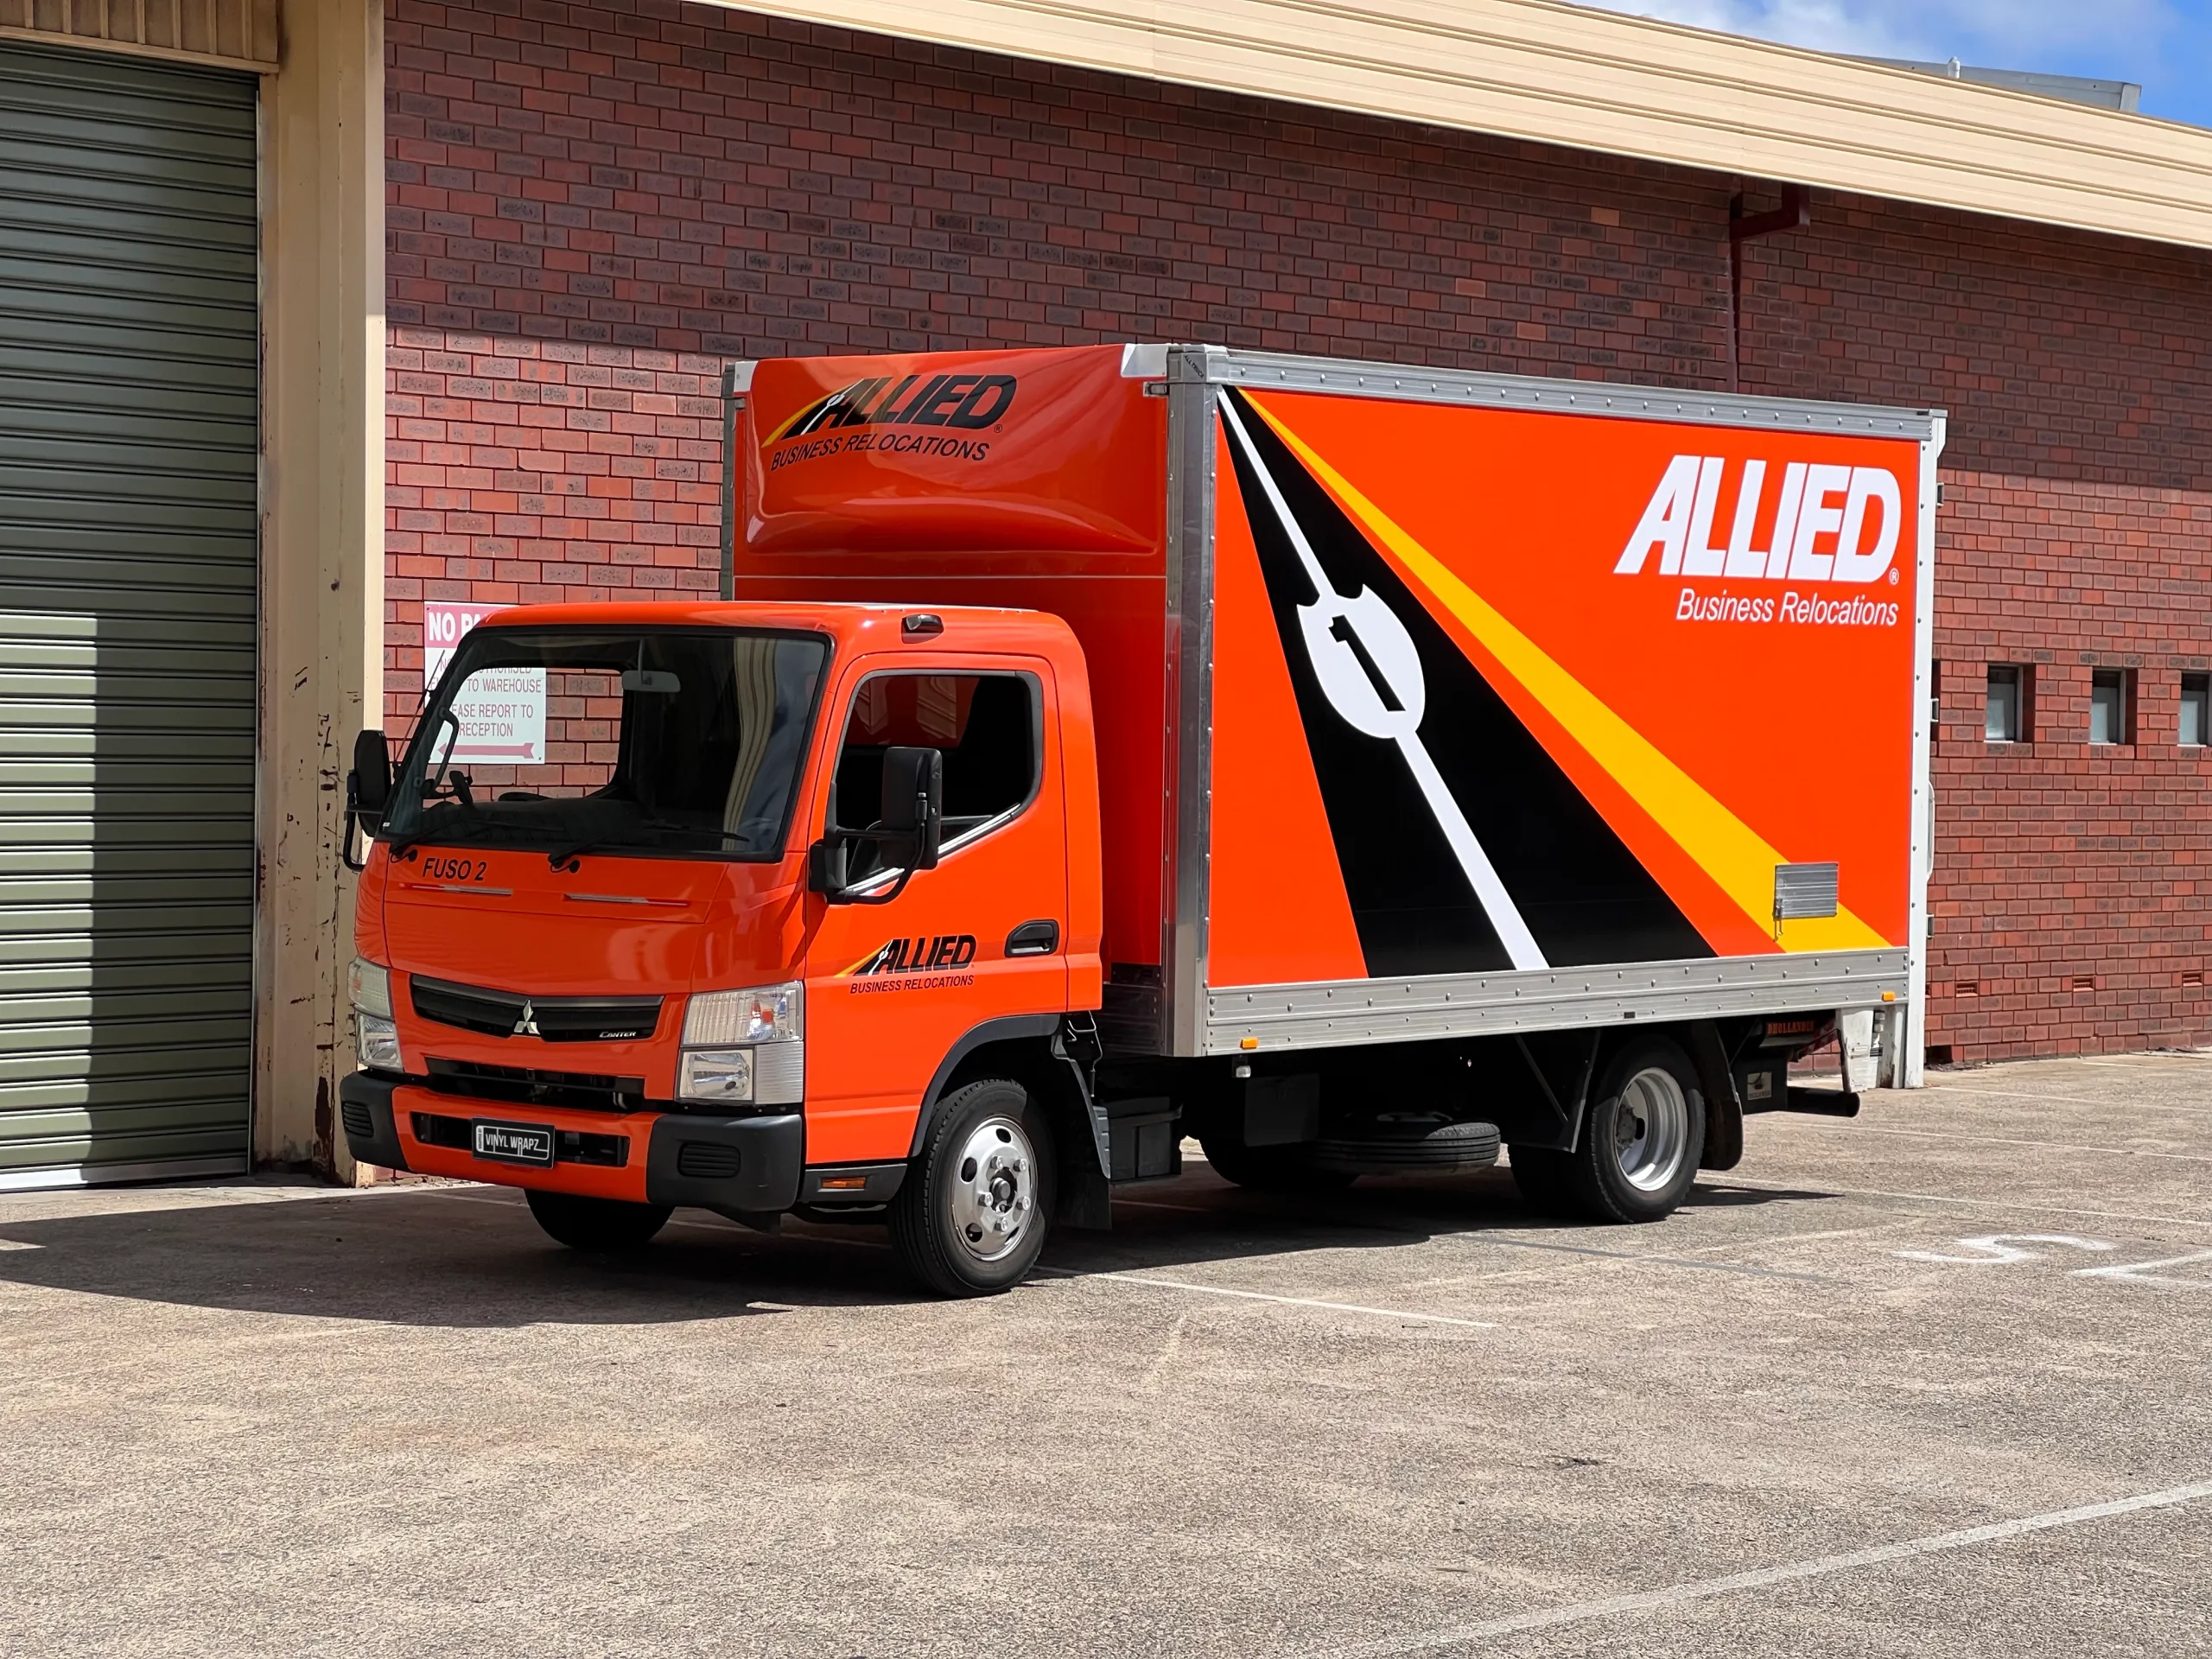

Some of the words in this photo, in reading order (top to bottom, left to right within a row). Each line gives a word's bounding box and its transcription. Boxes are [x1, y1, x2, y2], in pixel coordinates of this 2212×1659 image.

[779, 374, 1017, 441] ALLIED
[770, 435, 843, 472] BUSINESS
[842, 433, 990, 461] RELOCATIONS
[1612, 454, 1902, 583] ALLIED
[1675, 587, 1776, 623] Business
[1778, 591, 1899, 626] Relocations
[428, 611, 456, 642] NO
[467, 677, 480, 692] TO
[482, 677, 542, 693] WAREHOUSE
[450, 703, 476, 717] EASE
[479, 703, 518, 718] REPORT
[520, 704, 534, 718] TO
[459, 721, 513, 737] RECEPTION
[422, 857, 471, 880] FUSO
[474, 861, 486, 881] 2
[852, 934, 977, 976] ALLIED
[850, 980, 901, 994] BUSINESS
[904, 975, 974, 990] RELOCATIONS
[485, 1133, 508, 1148] VINYL
[510, 1135, 540, 1151] WRAPZ
